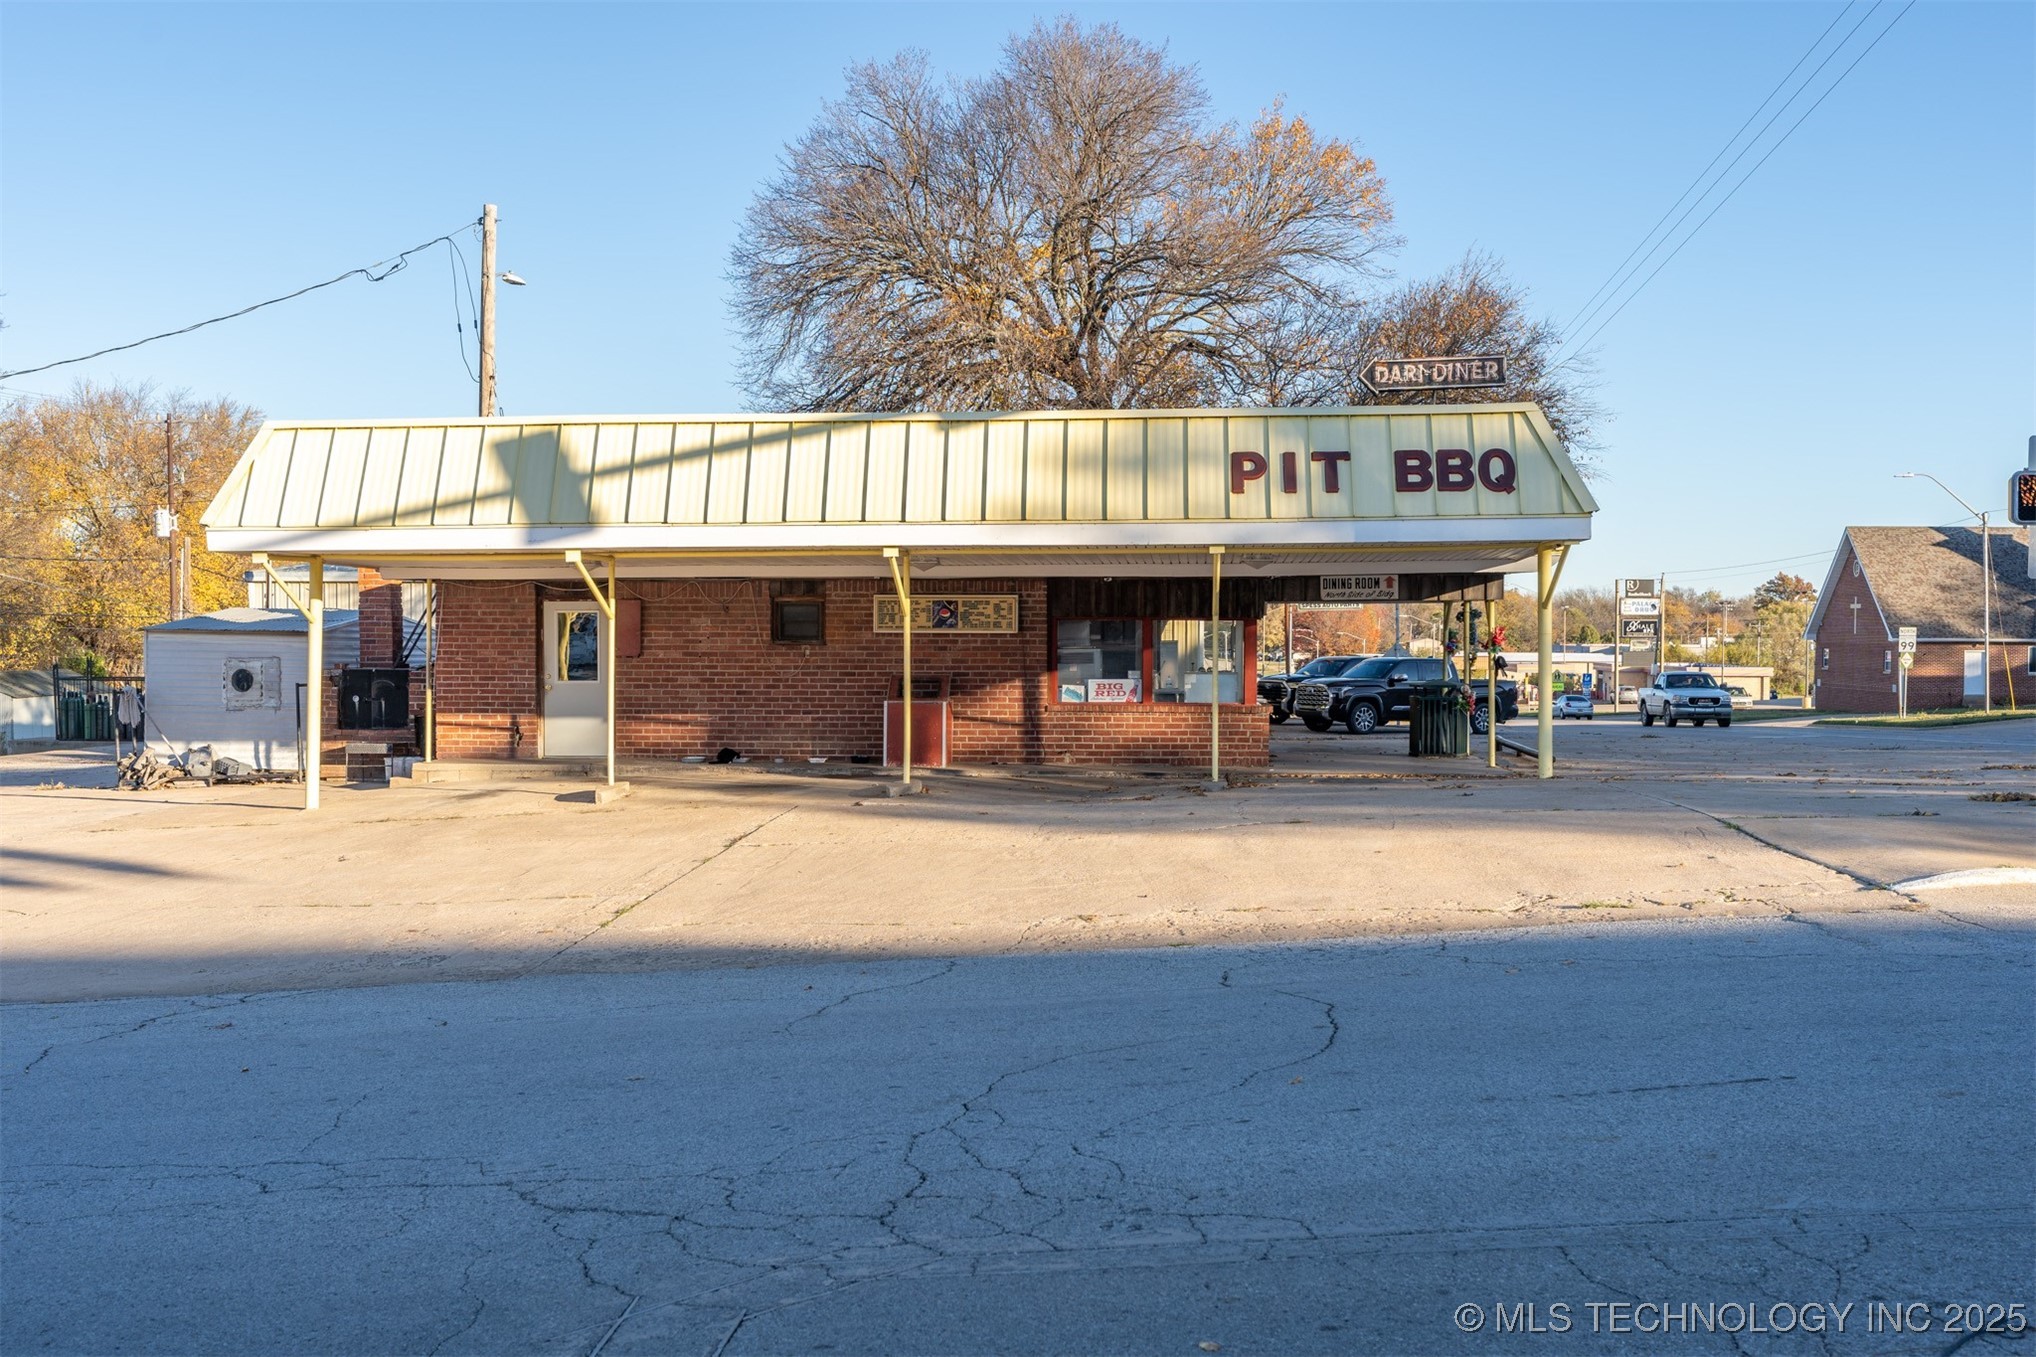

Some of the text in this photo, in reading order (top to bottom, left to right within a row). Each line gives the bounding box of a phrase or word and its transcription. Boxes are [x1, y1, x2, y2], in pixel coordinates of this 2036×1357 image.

[1230, 448, 1516, 495] PIT BBQ
[1322, 577, 1380, 590] DINING ROOM
[1324, 591, 1346, 599] North
[1347, 590, 1364, 599] Side
[1365, 590, 1376, 598] of
[1901, 641, 1915, 650] 99
[1096, 682, 1124, 690] BIG
